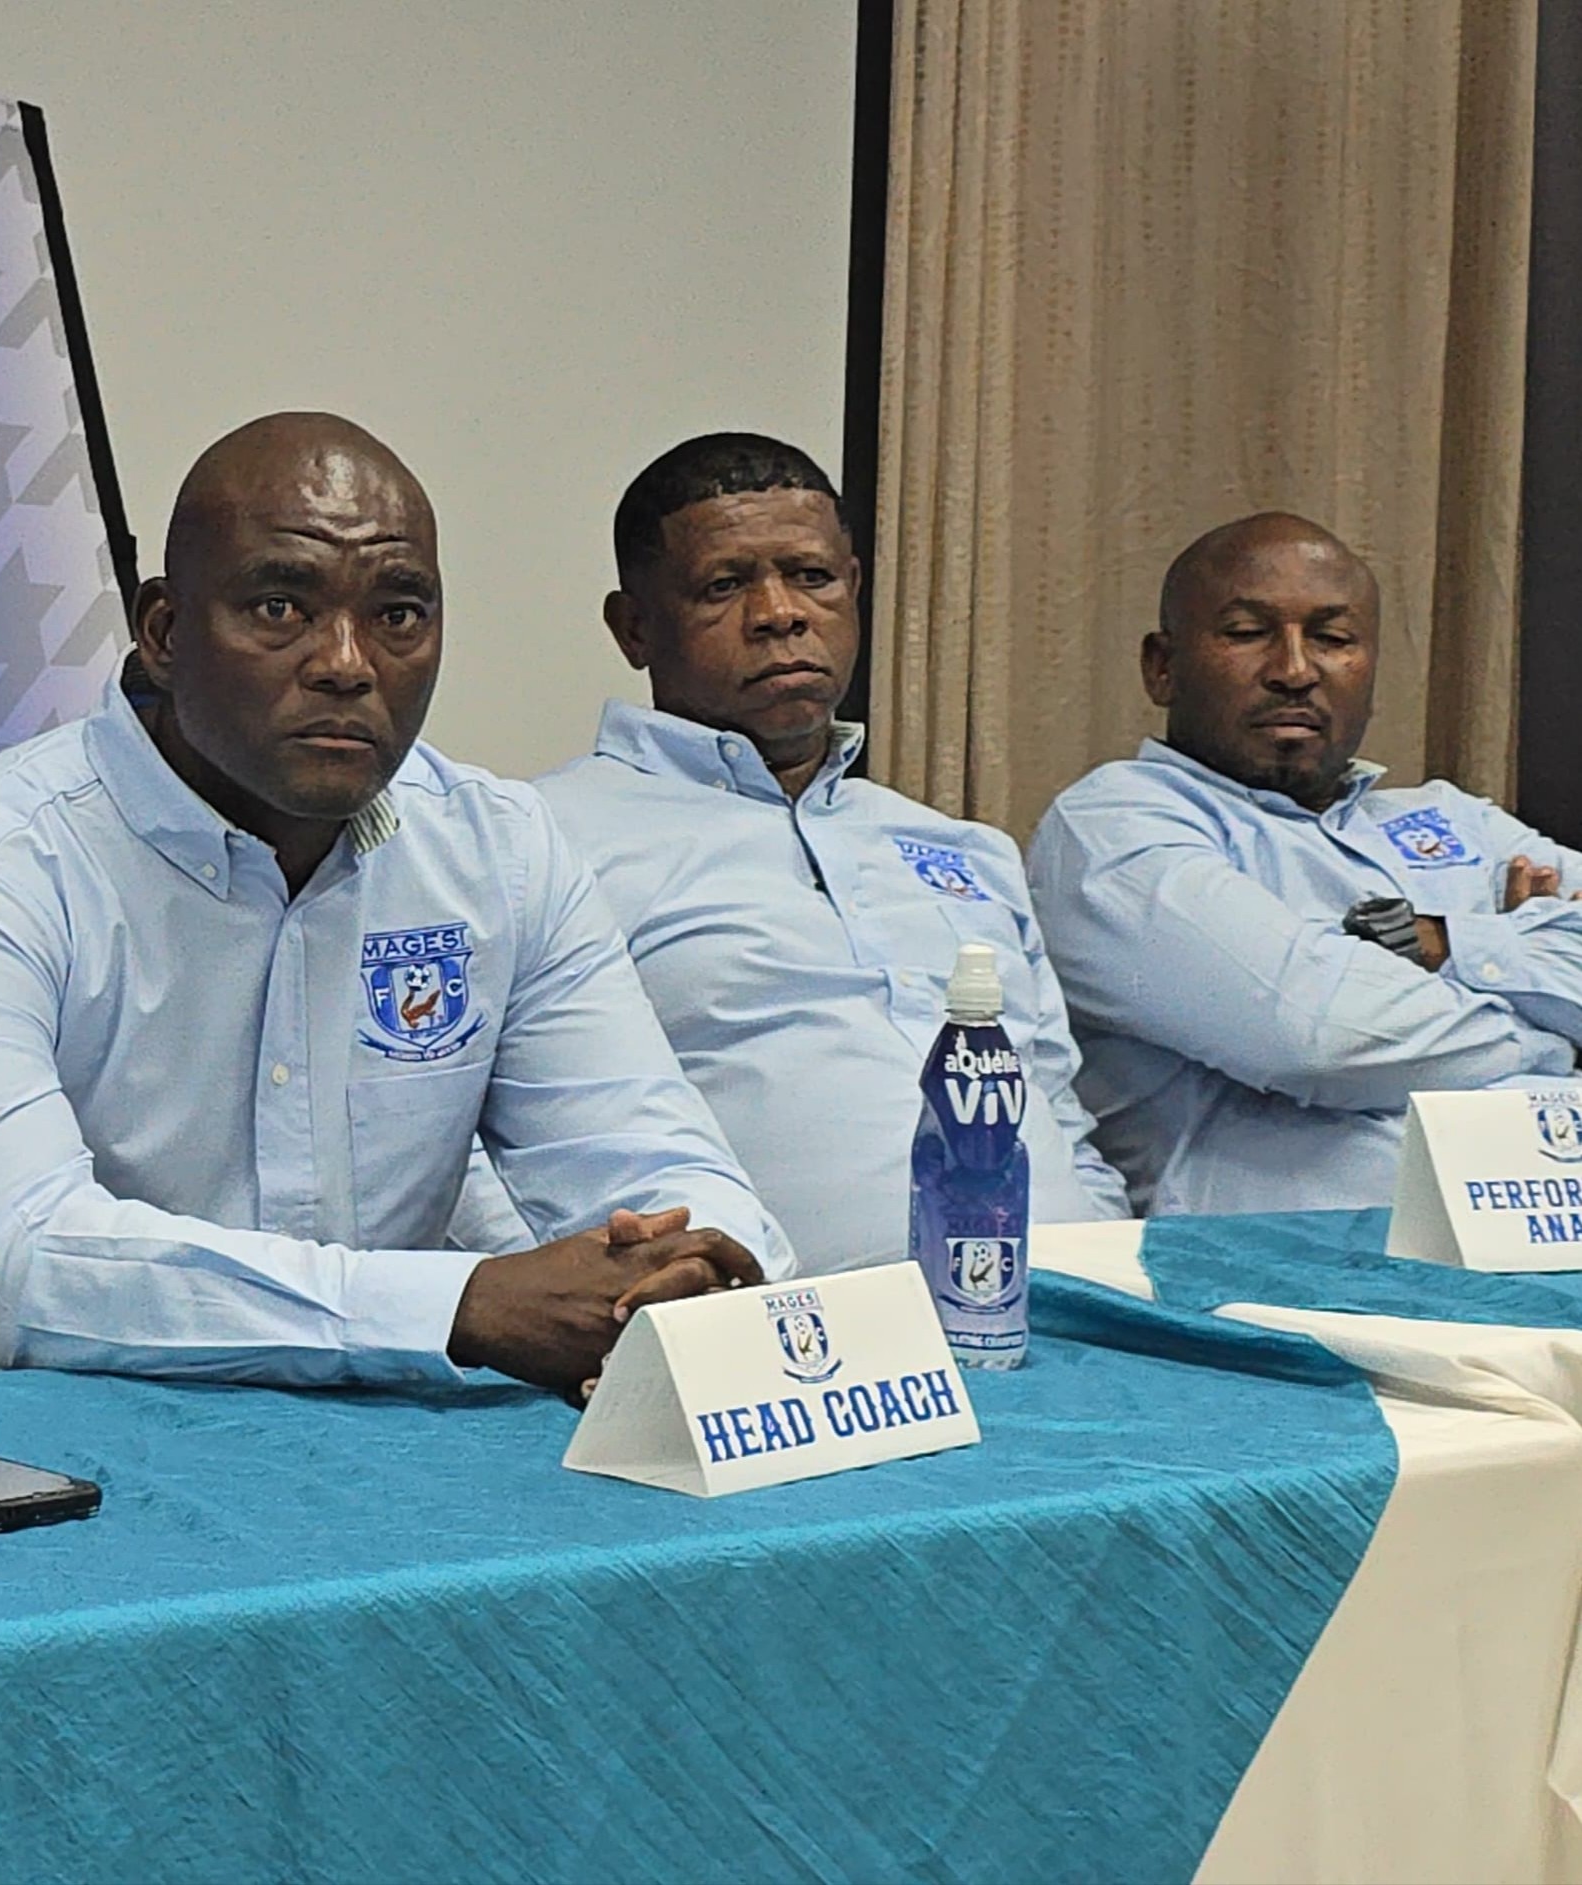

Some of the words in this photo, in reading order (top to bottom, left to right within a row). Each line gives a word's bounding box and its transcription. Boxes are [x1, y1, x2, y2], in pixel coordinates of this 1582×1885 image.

[362, 927, 466, 960] MAGESI
[696, 1397, 816, 1464] HEAD
[822, 1368, 961, 1439] COACH
